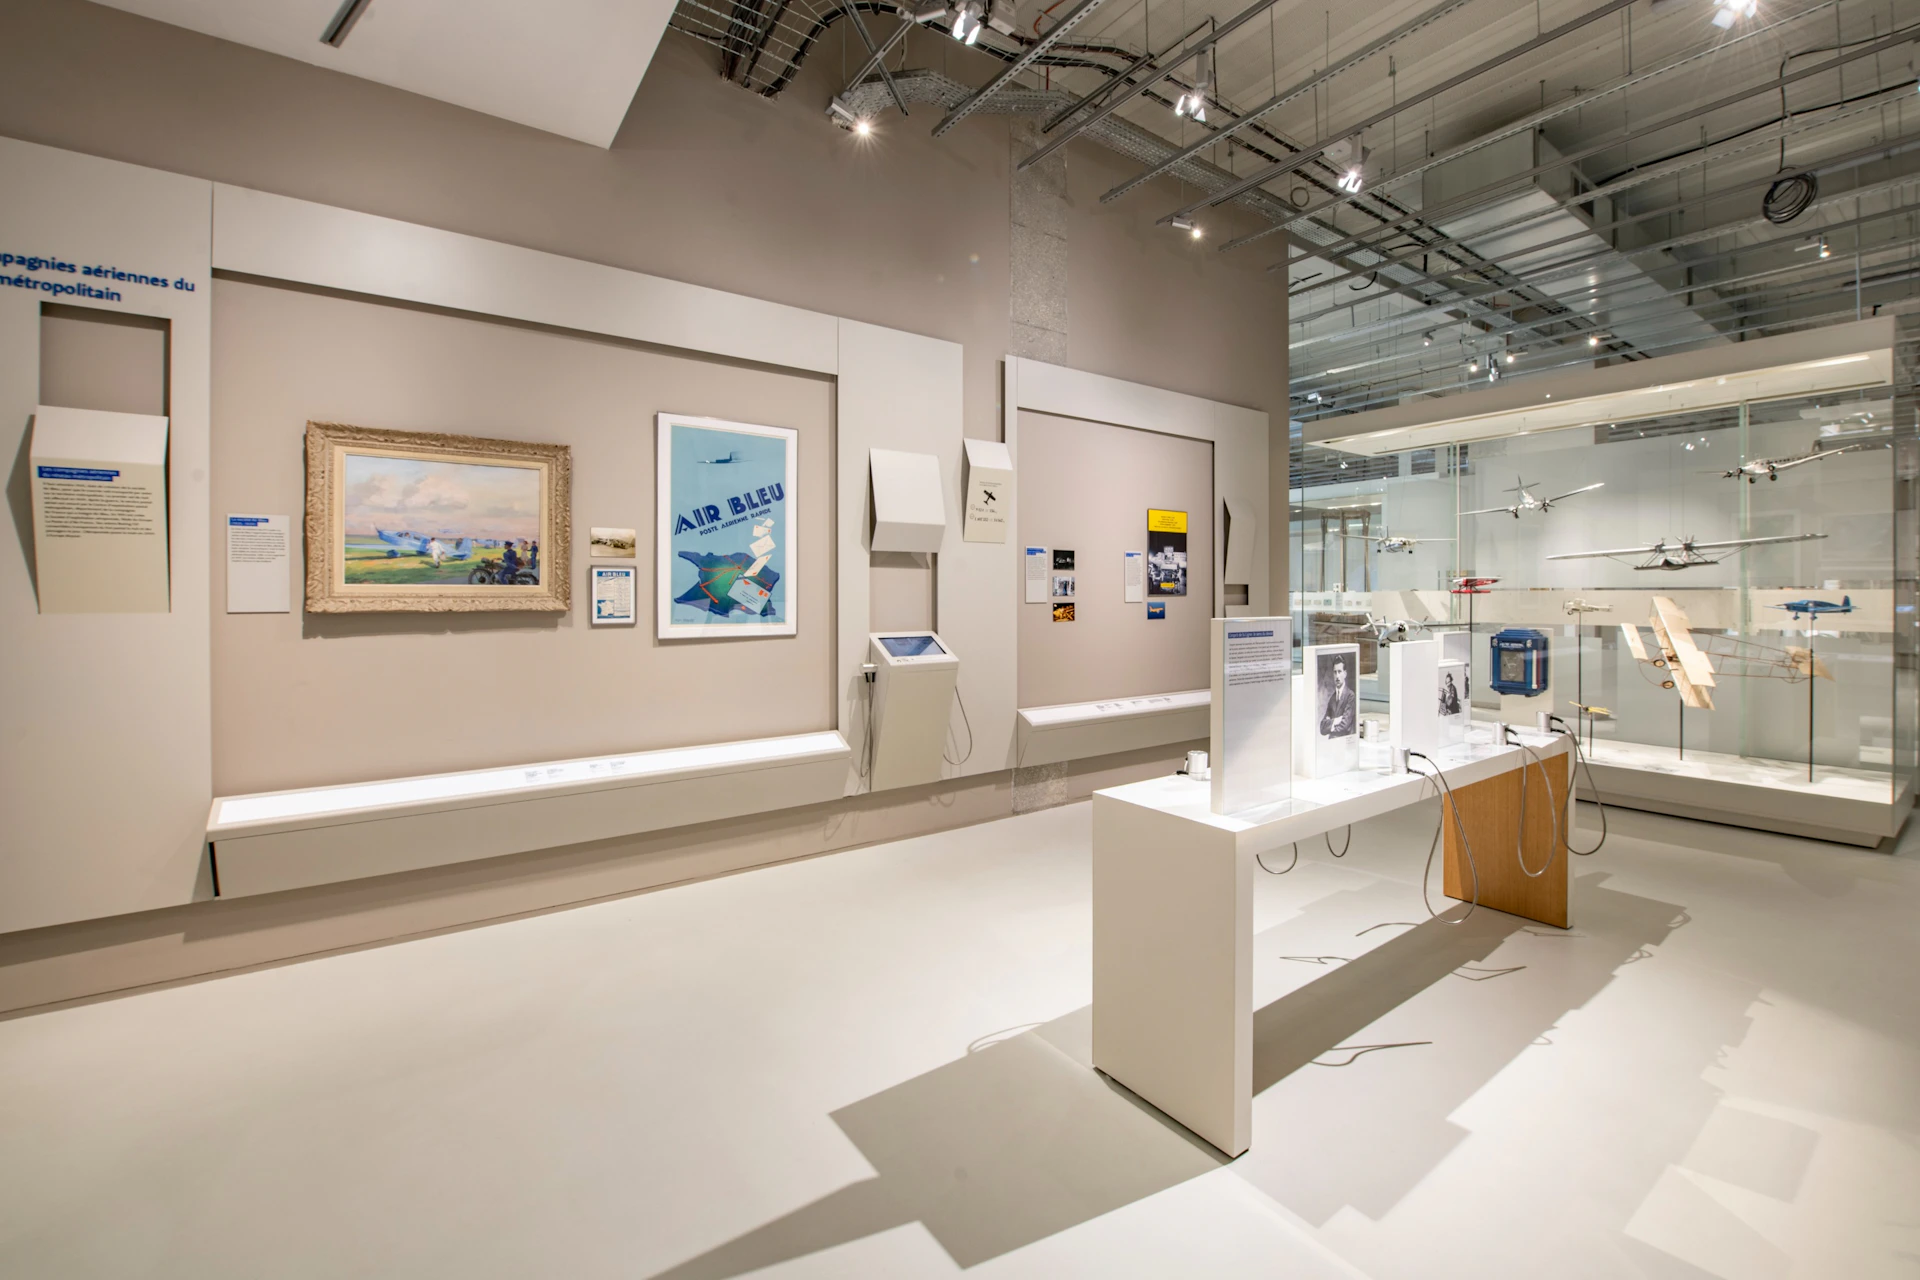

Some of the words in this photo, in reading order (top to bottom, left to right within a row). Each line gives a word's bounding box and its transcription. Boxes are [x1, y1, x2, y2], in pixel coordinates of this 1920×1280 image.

[0, 273, 121, 302] métropolitain
[82, 263, 168, 288] aériennes
[174, 278, 195, 292] du
[674, 504, 722, 535] AIR
[727, 482, 784, 516] BLEU
[700, 525, 718, 536] POSTE
[751, 508, 771, 519] RAPIDE
